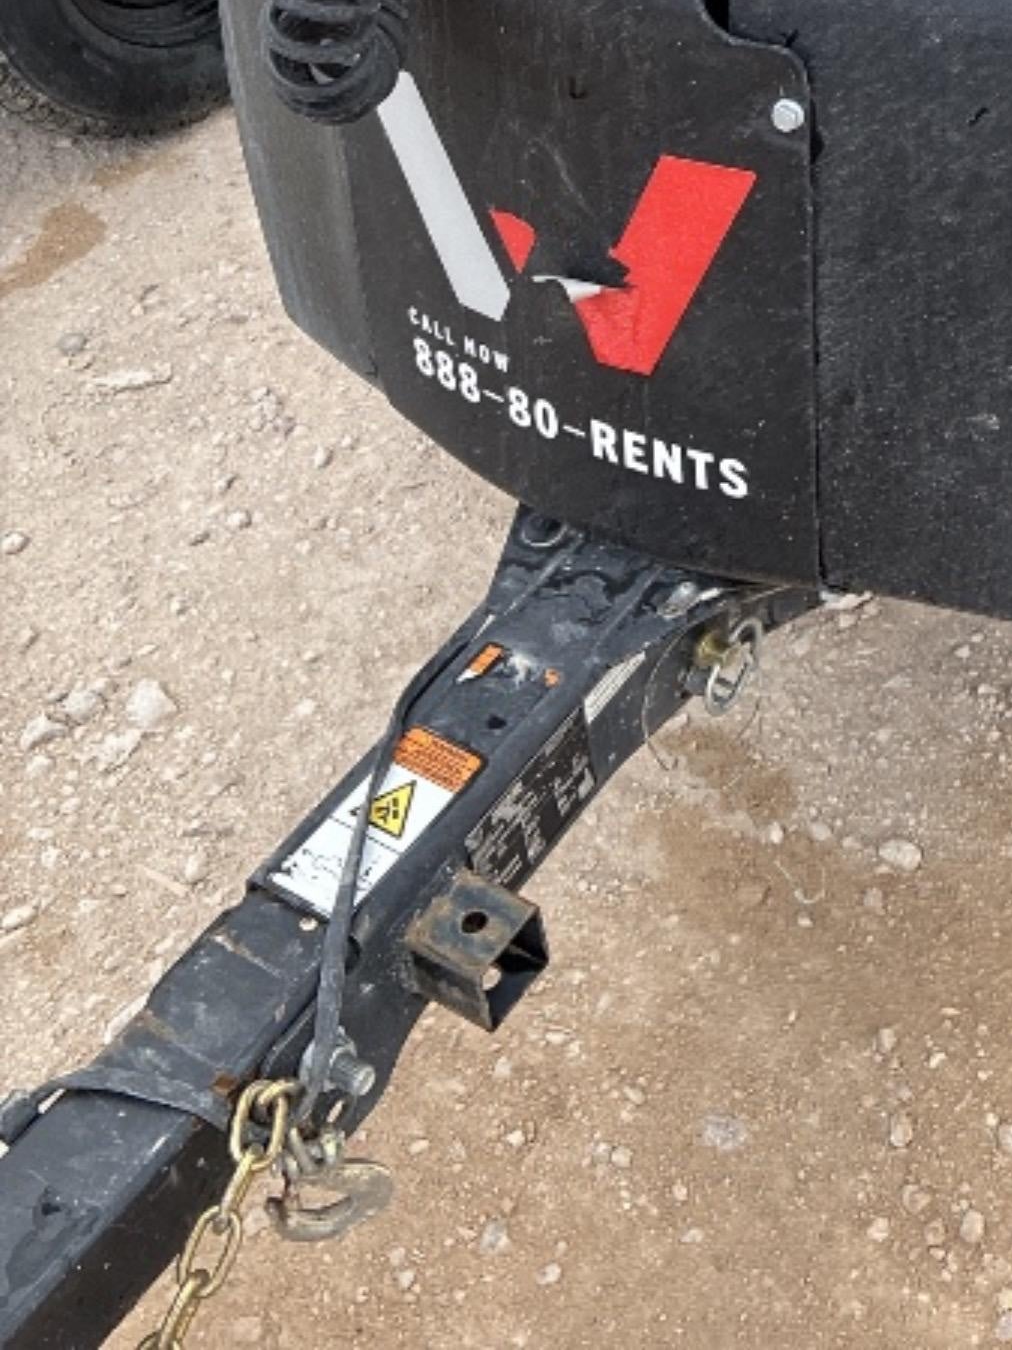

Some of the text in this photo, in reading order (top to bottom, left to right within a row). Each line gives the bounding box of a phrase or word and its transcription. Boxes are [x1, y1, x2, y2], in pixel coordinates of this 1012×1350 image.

[407, 305, 511, 373] CALL NOW
[412, 336, 750, 499] 888-80-RENTS
